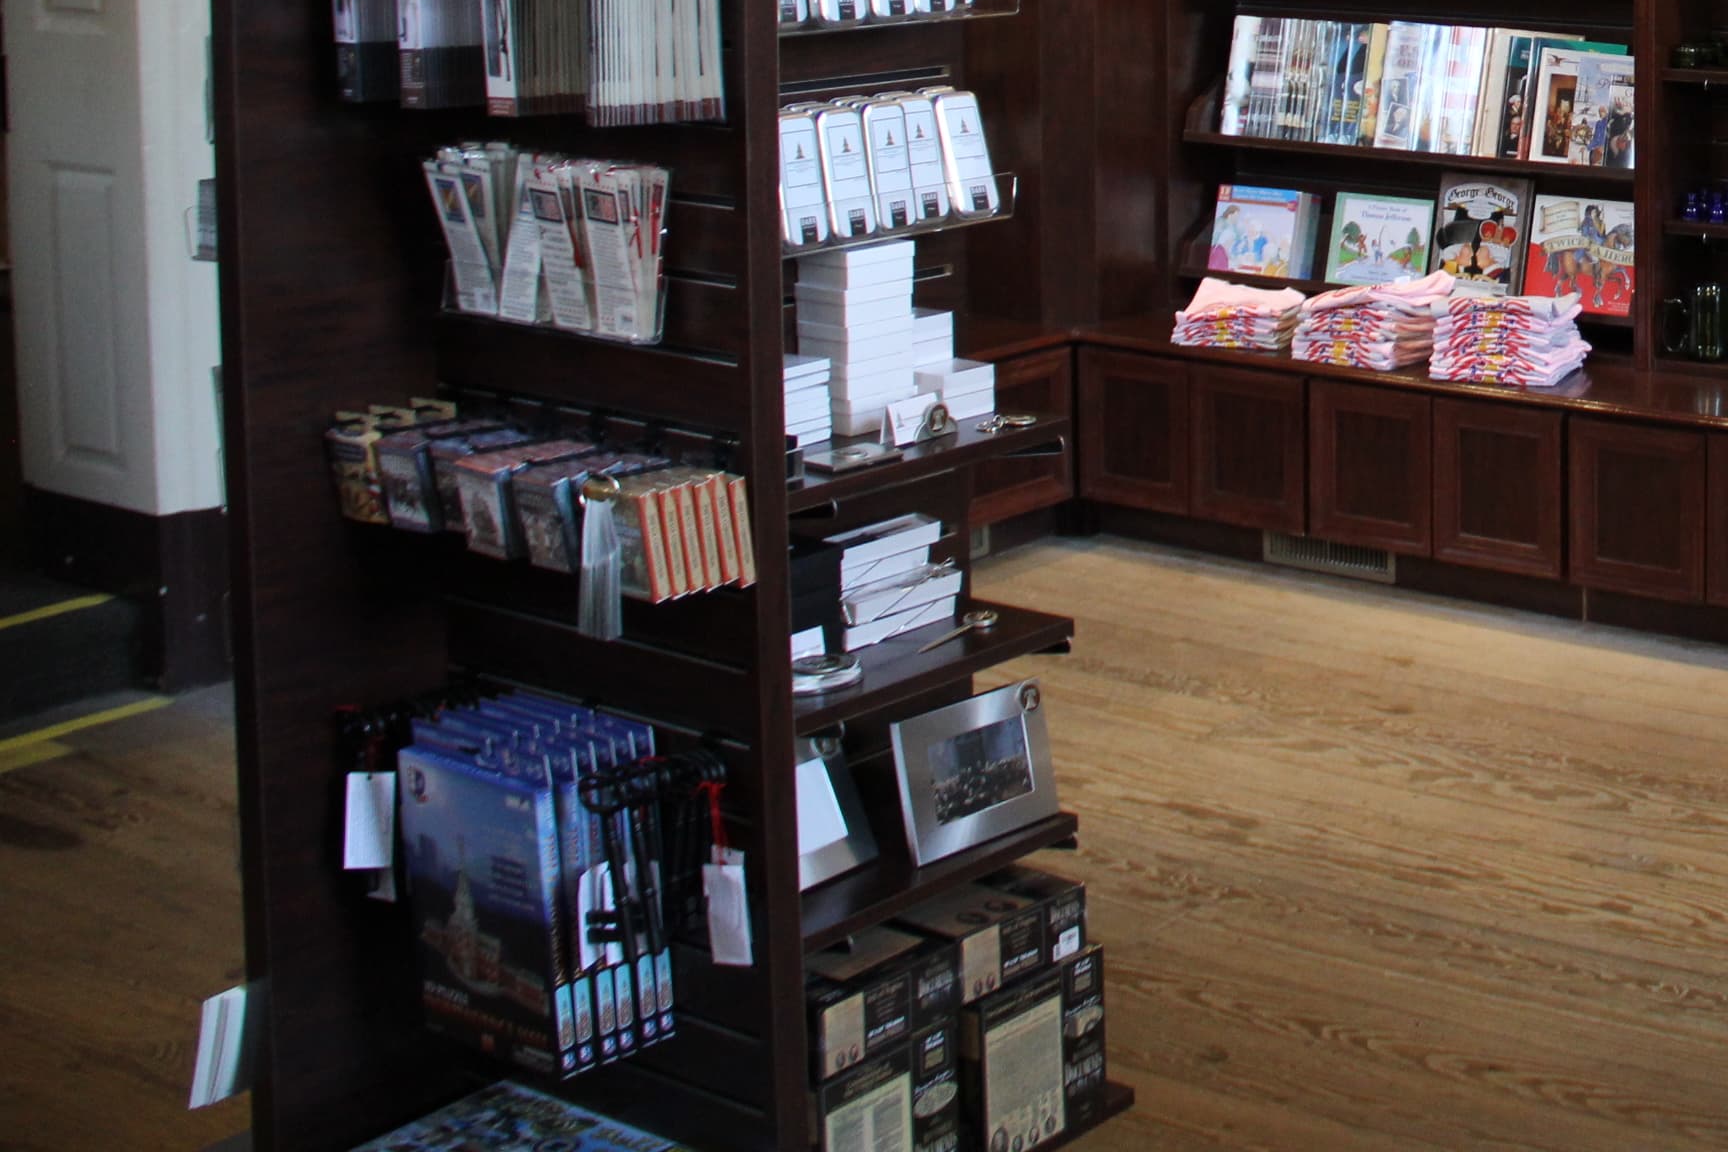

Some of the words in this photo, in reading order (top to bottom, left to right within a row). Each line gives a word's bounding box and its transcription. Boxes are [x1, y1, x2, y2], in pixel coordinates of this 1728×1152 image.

[1450, 186, 1480, 201] George
[1484, 186, 1515, 208] George
[1548, 236, 1584, 248] TWICE
